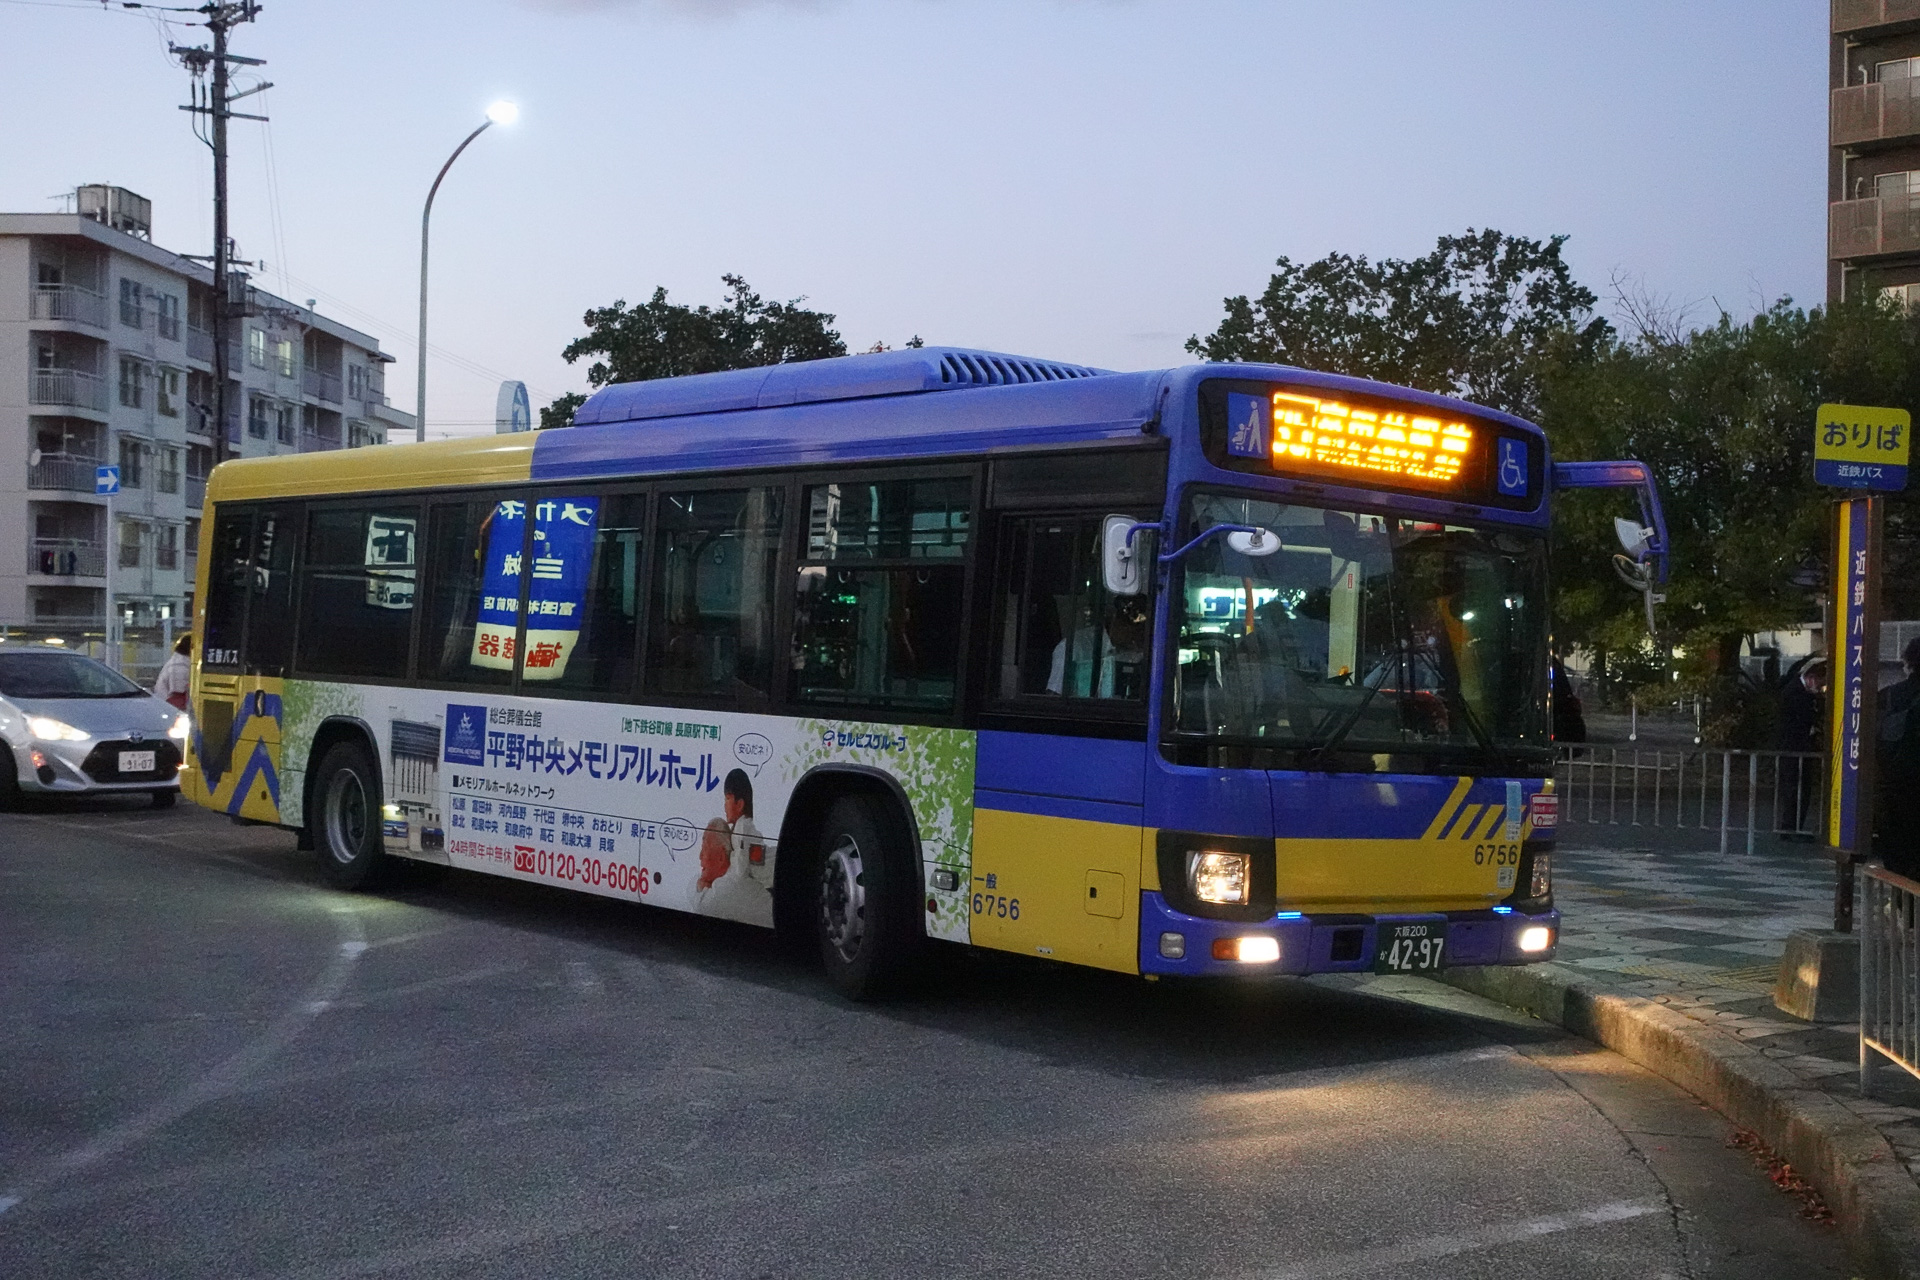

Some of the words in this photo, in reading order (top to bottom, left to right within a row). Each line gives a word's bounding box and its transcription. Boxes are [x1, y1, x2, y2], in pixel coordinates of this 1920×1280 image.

[1823, 422, 1903, 451] おりば
[1838, 465, 1882, 479] 近鉄バス
[490, 707, 542, 727] 総合葬儀会館
[487, 731, 720, 792] 平野中央メモリアルホール
[471, 817, 498, 833] 和泉中央
[505, 822, 533, 839] 和泉府中
[561, 831, 592, 849] 和泉大津
[499, 803, 527, 820] 河内長野
[533, 808, 555, 825] 千代田
[592, 818, 623, 835] おおとり
[450, 840, 512, 864] 24時間年中無休
[1474, 844, 1518, 865] 6756
[537, 850, 649, 894] 0120-30-6066
[974, 873, 997, 889] 一般
[972, 893, 1020, 920] 6756
[1388, 938, 1444, 970] 42-97
